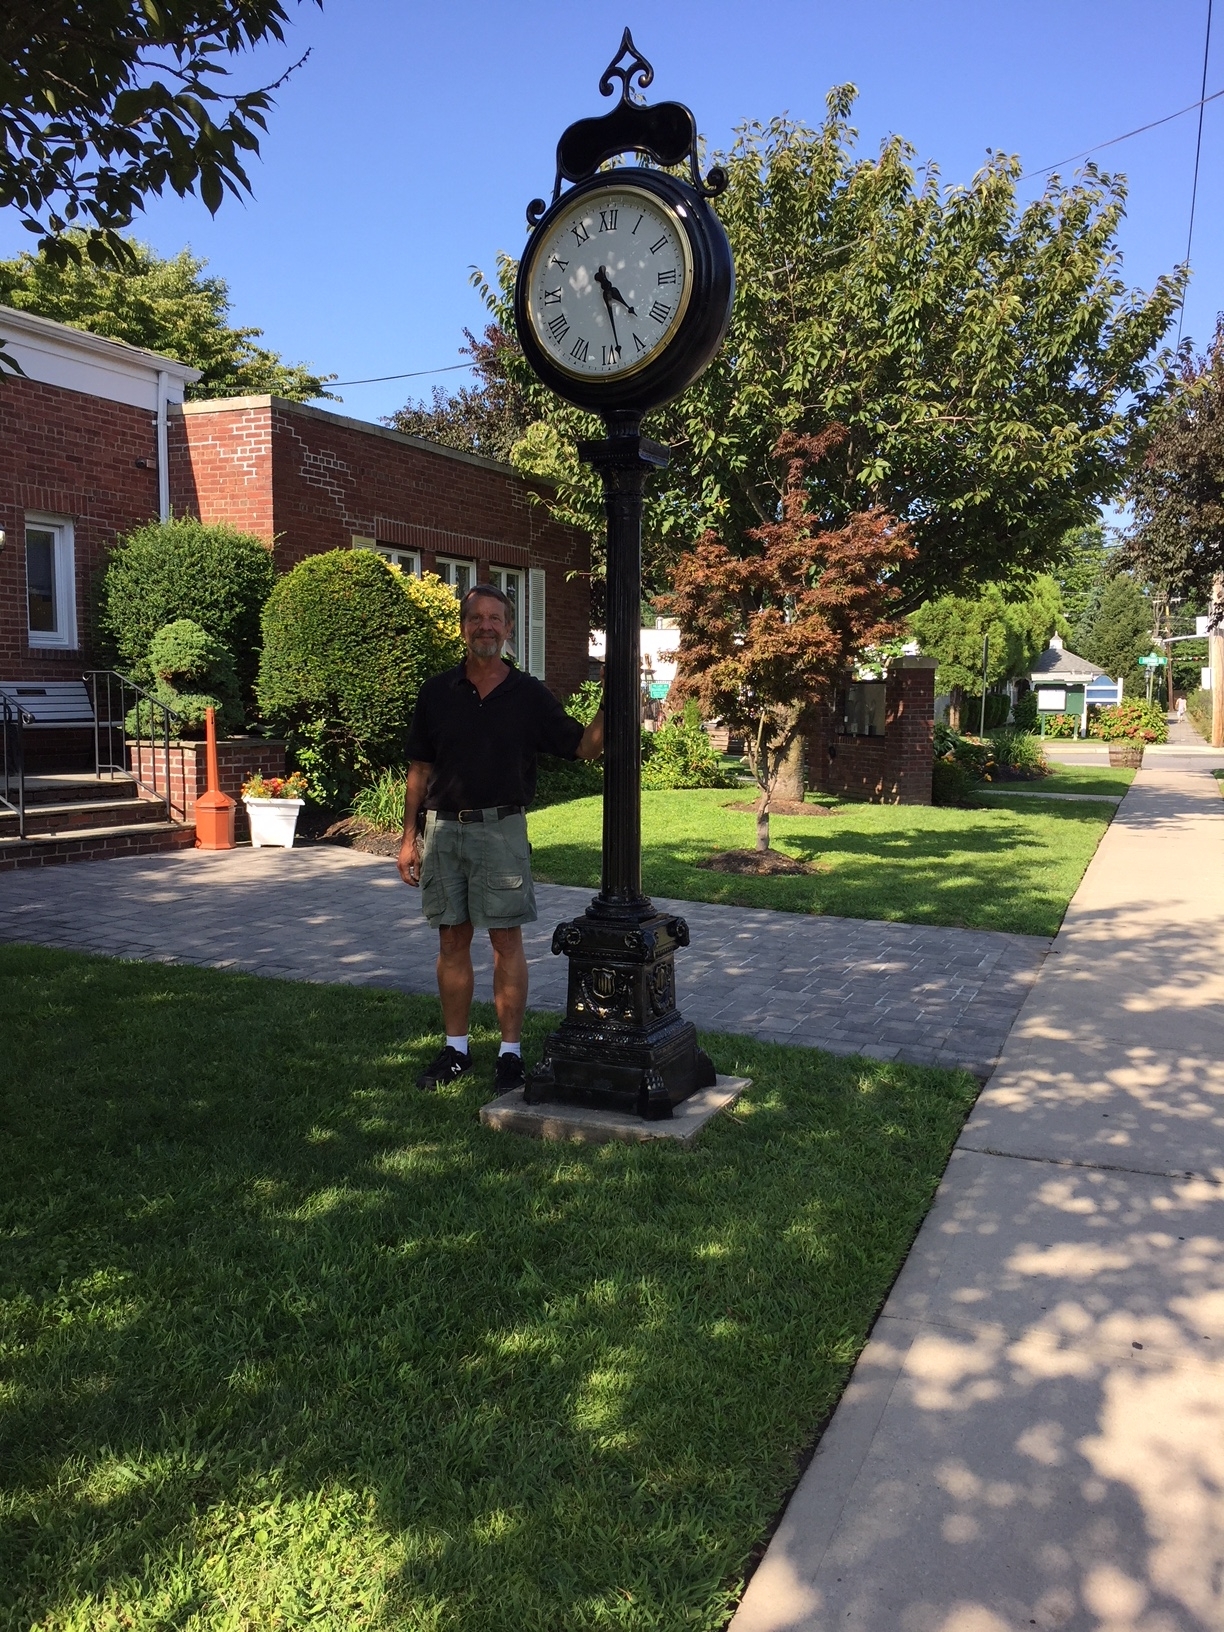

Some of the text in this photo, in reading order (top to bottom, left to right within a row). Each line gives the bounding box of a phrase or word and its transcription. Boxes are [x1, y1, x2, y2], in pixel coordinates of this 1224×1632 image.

[599, 209, 618, 232] XII
[632, 214, 644, 235] I
[571, 222, 590, 247] XI
[650, 235, 669, 255] II
[551, 255, 569, 272] X
[657, 268, 676, 286] III
[545, 287, 561, 306] IX
[548, 313, 571, 344] VIII
[570, 337, 589, 363] VII
[632, 332, 647, 353] V
[602, 344, 617, 366] VI
